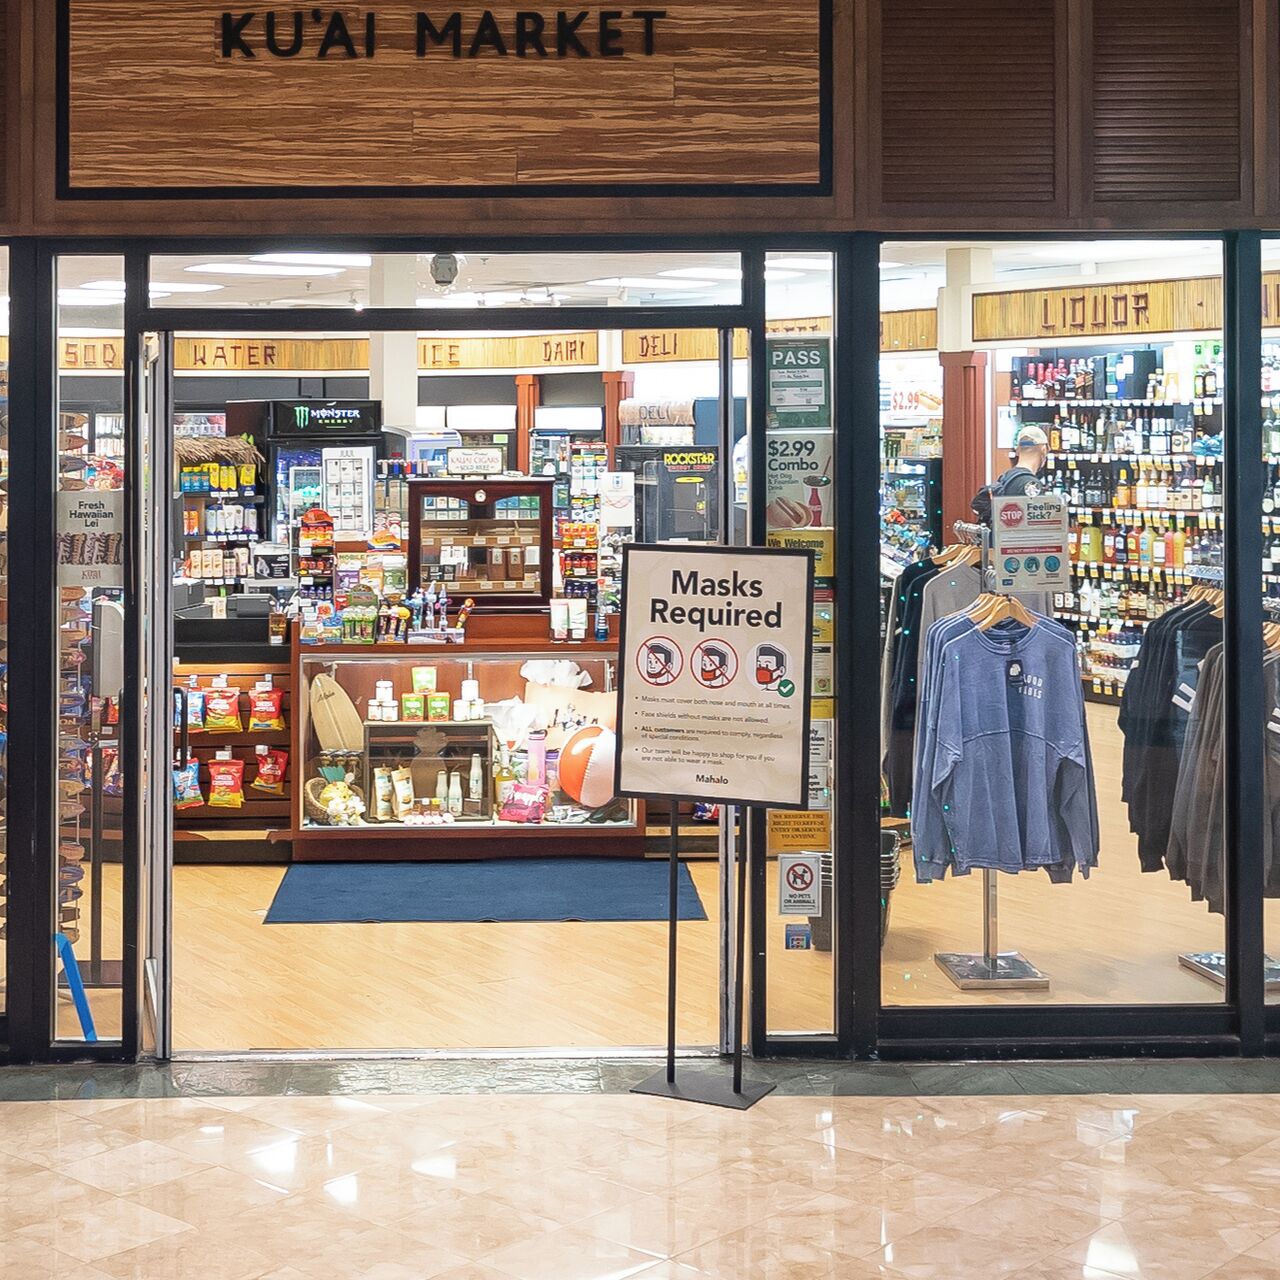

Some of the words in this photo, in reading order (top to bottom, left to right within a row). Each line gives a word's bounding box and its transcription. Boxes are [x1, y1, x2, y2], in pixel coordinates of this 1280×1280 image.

[416, 9, 667, 57] MARKET
[1040, 292, 1150, 331] LIQUOR
[543, 339, 587, 362] DAIRY
[639, 333, 678, 357] DELI
[193, 344, 277, 366] WATER
[423, 344, 461, 365] ICE
[772, 350, 821, 365] PASS
[310, 408, 361, 419] MONSTER
[768, 440, 816, 458] $2.99
[768, 458, 819, 472] Combo
[78, 500, 105, 510] Fresh
[1026, 503, 1062, 512] Feeling
[69, 510, 114, 519] Hawaiian
[1000, 511, 1023, 520] STOP
[1026, 511, 1051, 520] Sick?
[84, 519, 99, 527] Lei
[768, 539, 782, 548] We
[671, 570, 763, 597] Masks
[650, 598, 782, 632] Required
[695, 774, 729, 785] Mahalo
